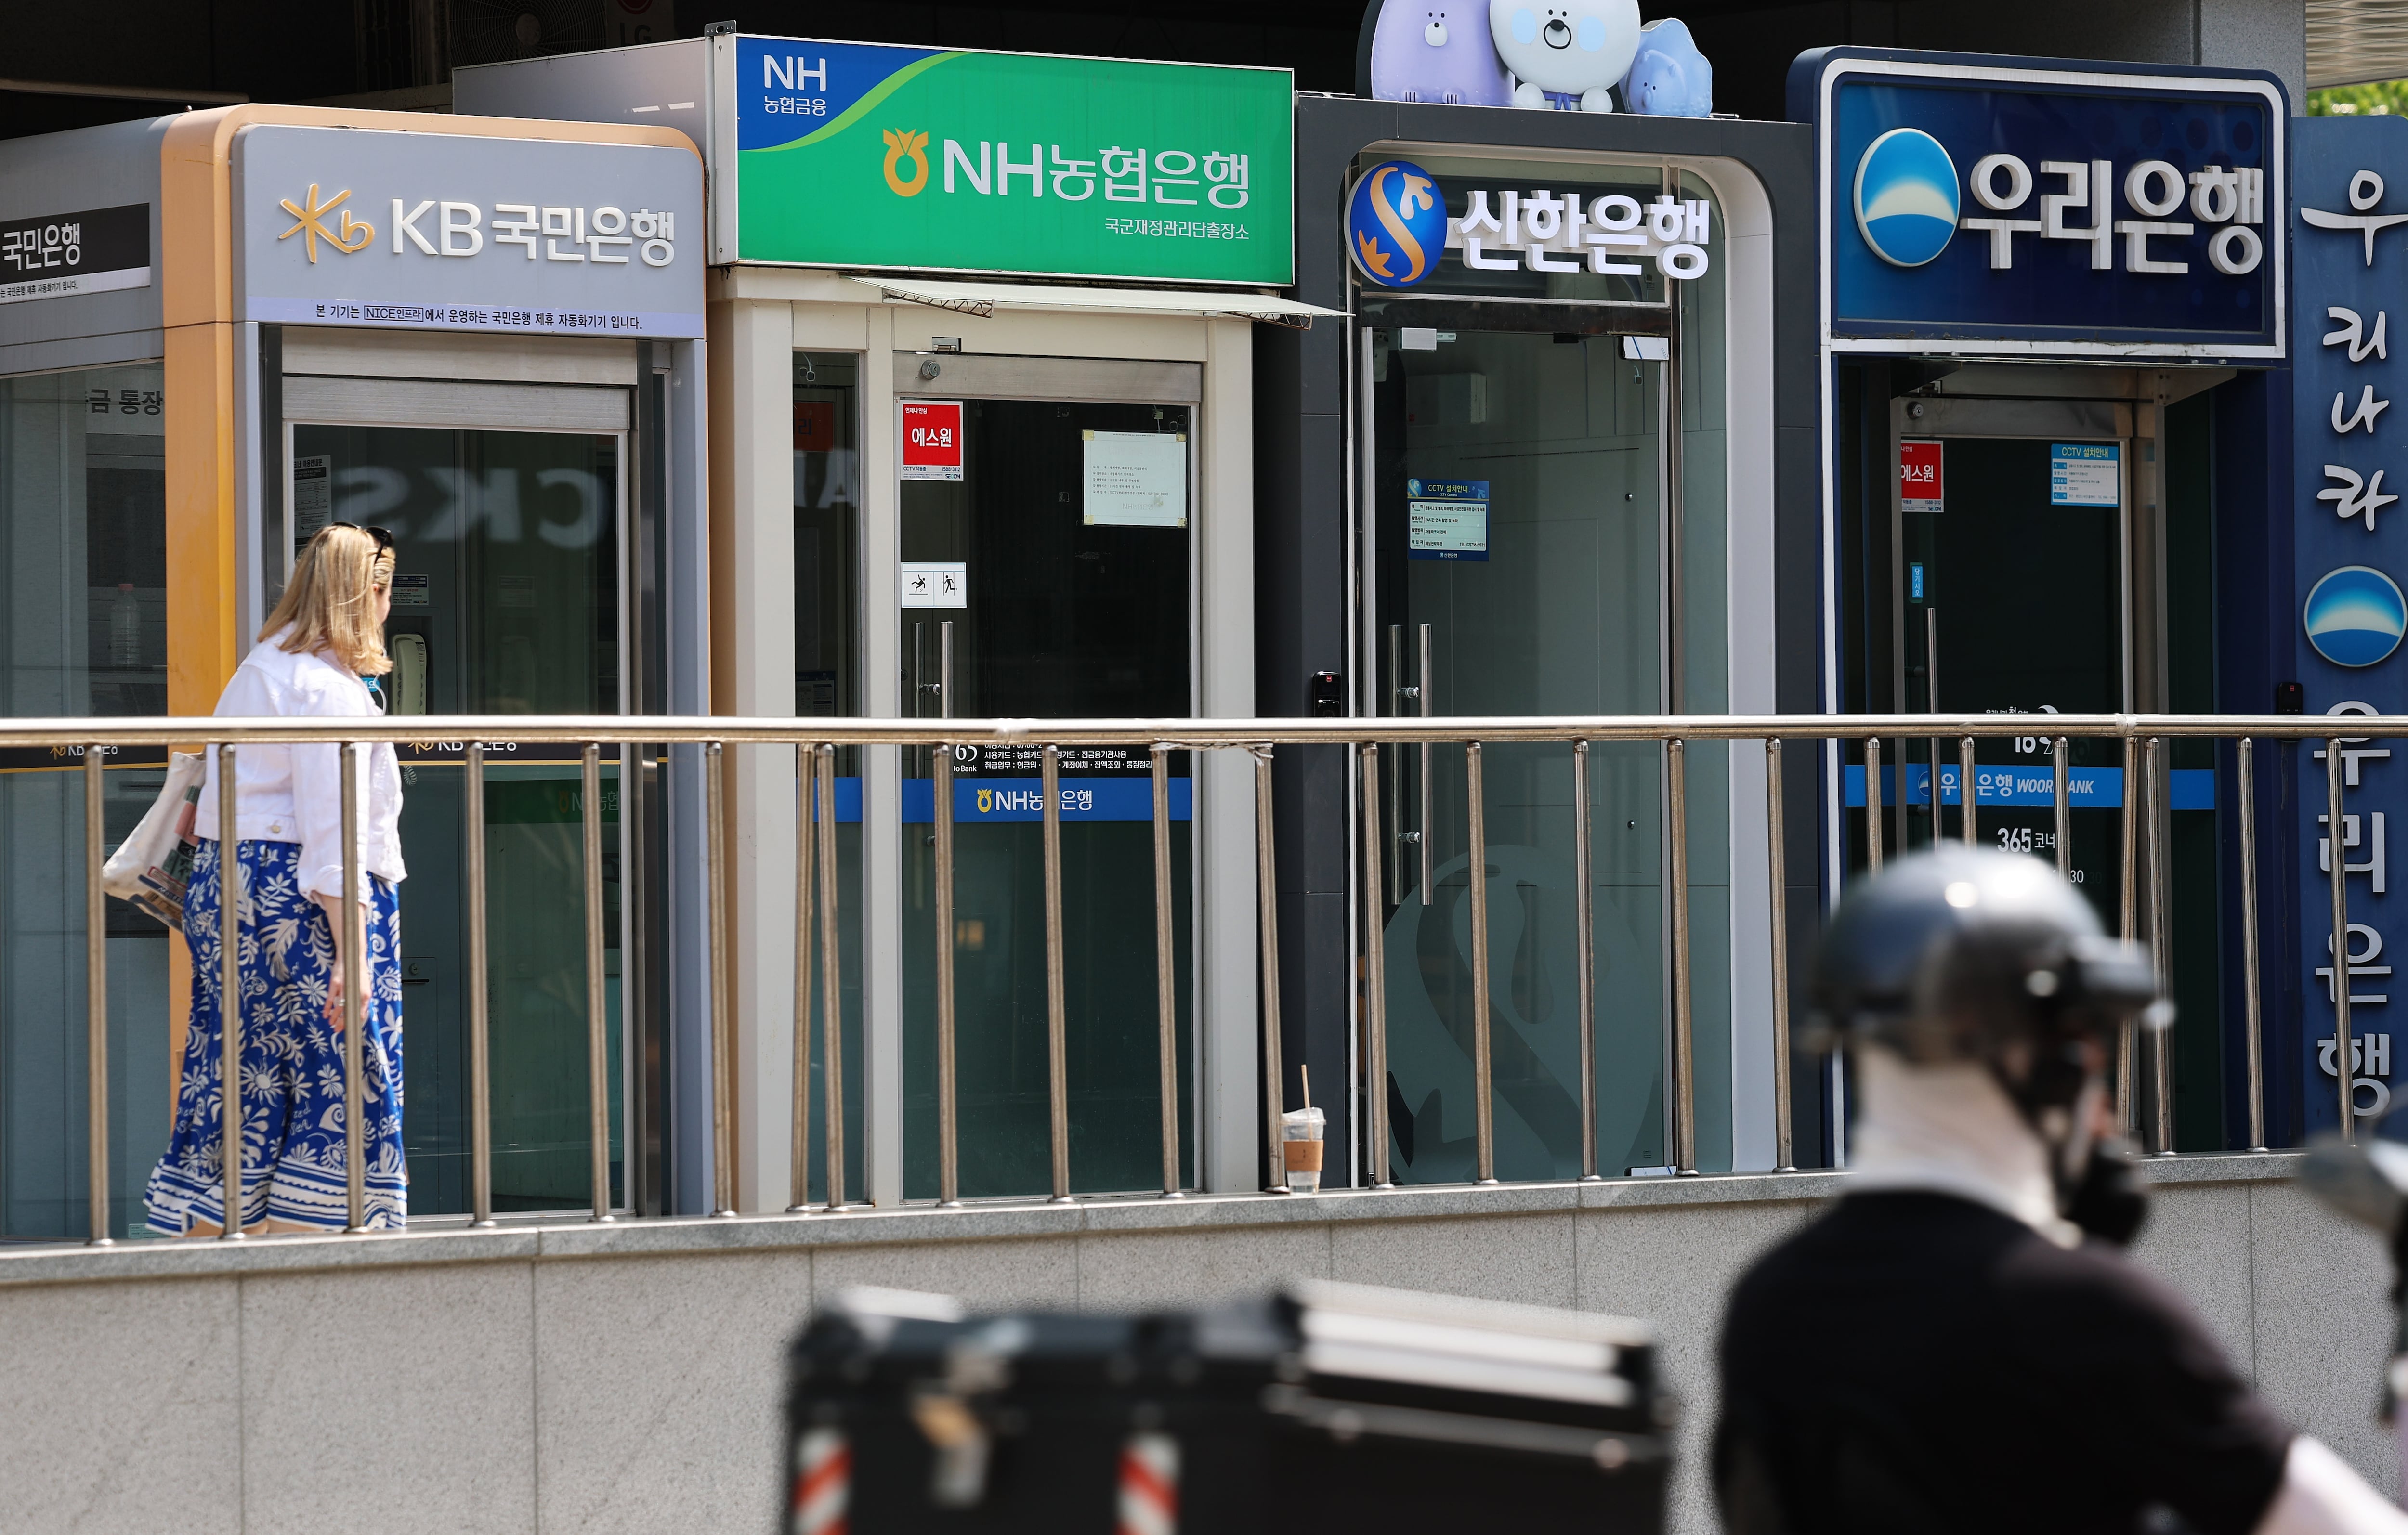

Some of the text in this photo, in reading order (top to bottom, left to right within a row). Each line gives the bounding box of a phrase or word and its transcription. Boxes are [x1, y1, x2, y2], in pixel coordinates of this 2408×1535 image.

[620, 23, 652, 47] LG
[764, 54, 826, 91] NH
[764, 95, 827, 116] 농협금융
[944, 138, 1250, 209] NH농협은행
[1960, 154, 2263, 275] 우리은행
[392, 198, 675, 267] KB 국민은행
[1105, 218, 1250, 240] 국군재정관리단출장소
[1453, 189, 1709, 280] 신한은행
[2, 222, 80, 270] 국민은행
[7, 285, 26, 297] 국민은행
[315, 304, 643, 330] 본 기기는 NICE인프라 에서 운영하는 국민은행 제휴 자동화기기 입니다.
[2301, 169, 2408, 532] 우리나라
[85, 389, 163, 416] 금 통장
[912, 428, 952, 447] 에스원
[2062, 447, 2108, 458] CCTV 설치안내
[1901, 464, 1934, 482] 에스원
[1446, 485, 1468, 493] 설치안내
[984, 751, 1011, 759] 사용카드
[984, 761, 1011, 769] 취급업무
[1062, 761, 1088, 769] 계좌이체
[1094, 761, 1121, 769] 잔액조회
[1941, 773, 2095, 797] 우은행 WOOR ANK
[995, 789, 1093, 811] NH농은행
[1997, 828, 2055, 853] 365 코너
